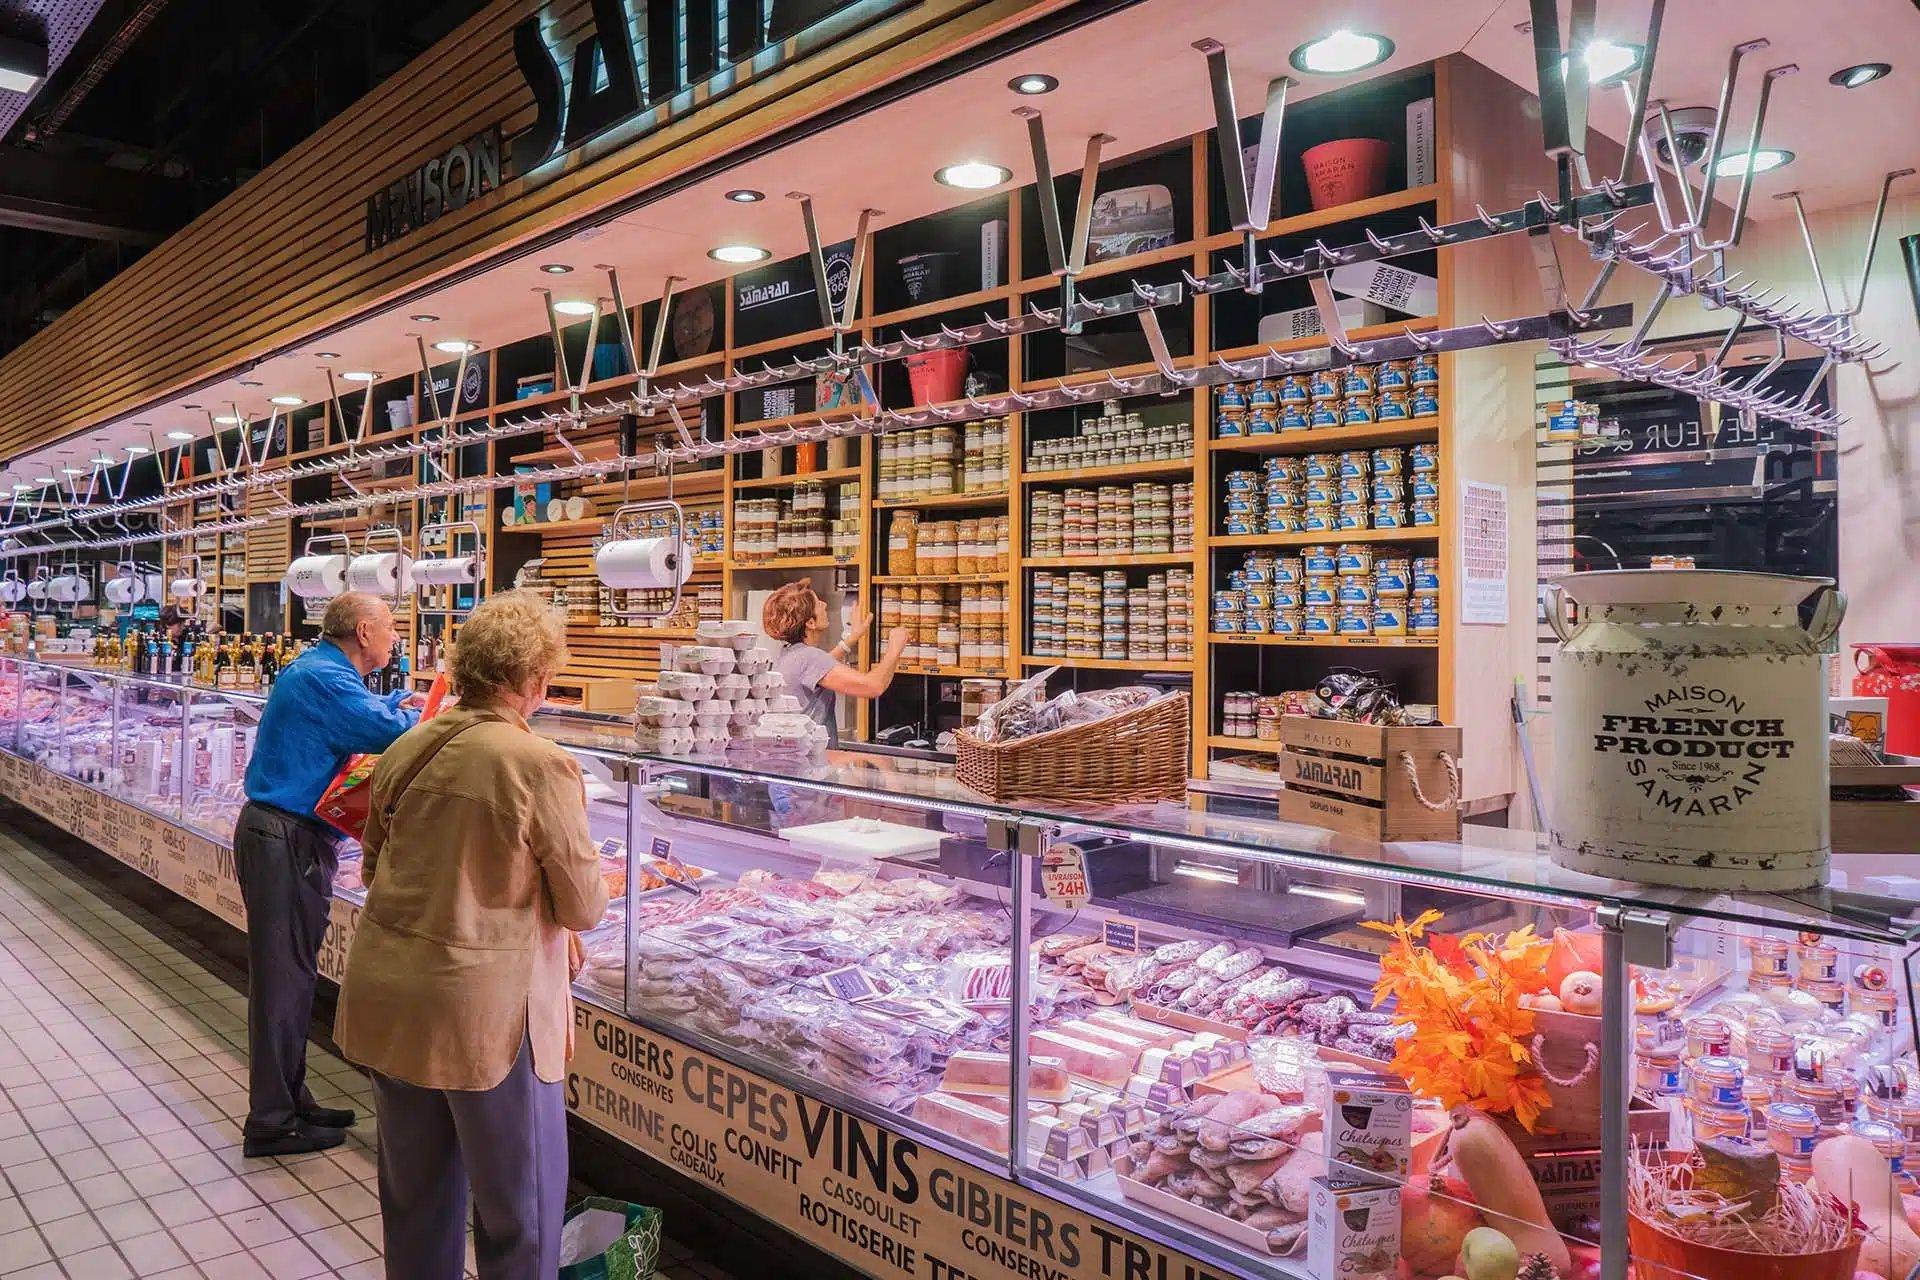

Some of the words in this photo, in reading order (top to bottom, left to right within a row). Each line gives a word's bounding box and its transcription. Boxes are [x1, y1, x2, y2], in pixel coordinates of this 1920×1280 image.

[366, 126, 500, 254] MAISON
[739, 281, 790, 308] SAMARAN
[1368, 266, 1389, 299] MAISON
[1644, 685, 1746, 715] MAISON
[1303, 729, 1352, 749] MAISON
[1594, 734, 1795, 759] PRODUCT
[1602, 714, 1785, 737] FRENCH
[1296, 758, 1362, 792] SAMARAN
[1627, 758, 1767, 817] SAMARAN
[1672, 760, 1697, 772] Since
[1699, 760, 1721, 772] 1968
[1048, 871, 1084, 881] LIVRAISON
[593, 1019, 675, 1081] GIBIERS
[611, 1061, 674, 1104] CONSERVES
[682, 1056, 788, 1142] CEPES
[583, 1076, 665, 1144] TERRINE
[670, 1123, 718, 1165] COLIS
[724, 1127, 803, 1185] CONFIT
[794, 1093, 920, 1205] VINS
[670, 1145, 726, 1188] CADEAUX
[822, 1176, 922, 1238] CASSOULET
[928, 1168, 1081, 1268] GIBIERS
[800, 1192, 915, 1275] ROTISSERIE
